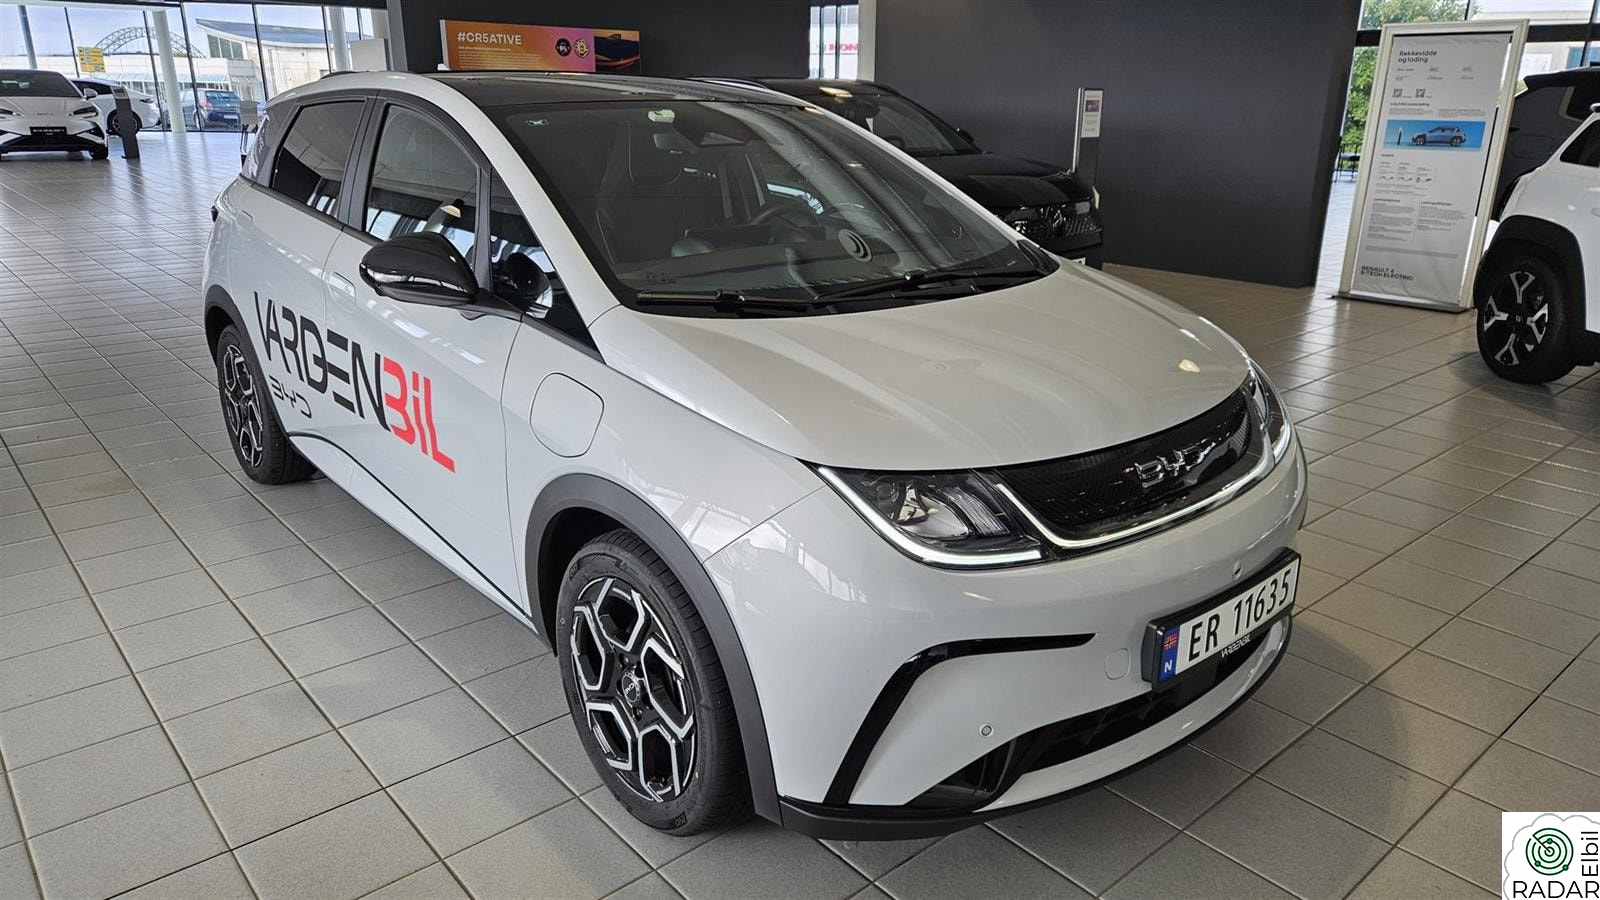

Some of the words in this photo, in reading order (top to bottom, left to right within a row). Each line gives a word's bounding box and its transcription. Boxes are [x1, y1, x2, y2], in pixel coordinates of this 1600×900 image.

[457, 31, 522, 45] #CR5ATIVE
[1133, 441, 1216, 488] BYD
[1188, 613, 1220, 662] ER
[1234, 569, 1292, 636] 11635
[1164, 659, 1173, 673] N
